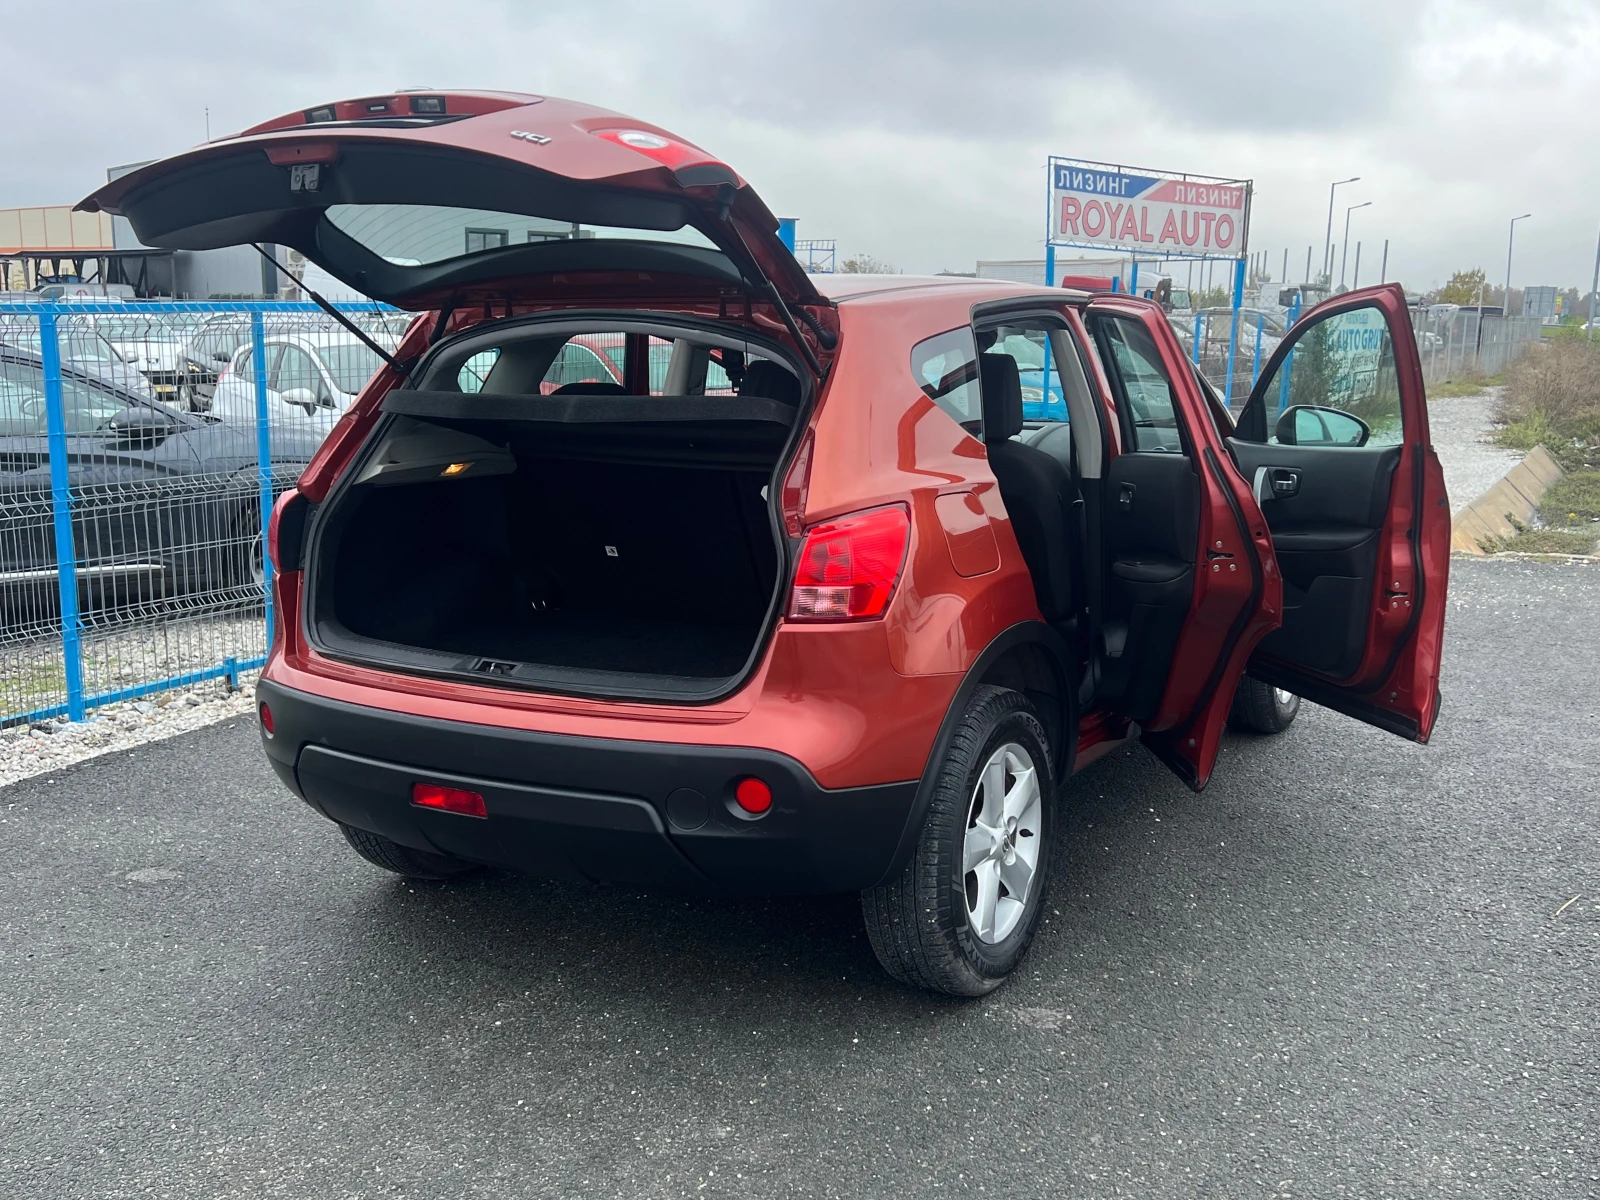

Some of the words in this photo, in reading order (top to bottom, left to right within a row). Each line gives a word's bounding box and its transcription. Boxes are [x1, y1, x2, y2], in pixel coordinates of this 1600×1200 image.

[1058, 170, 1130, 195] ЛИЗИНГ
[1174, 185, 1240, 207] ЛИЗИНГ
[1061, 197, 1154, 242] ROYAL
[1159, 209, 1234, 249] AUTO
